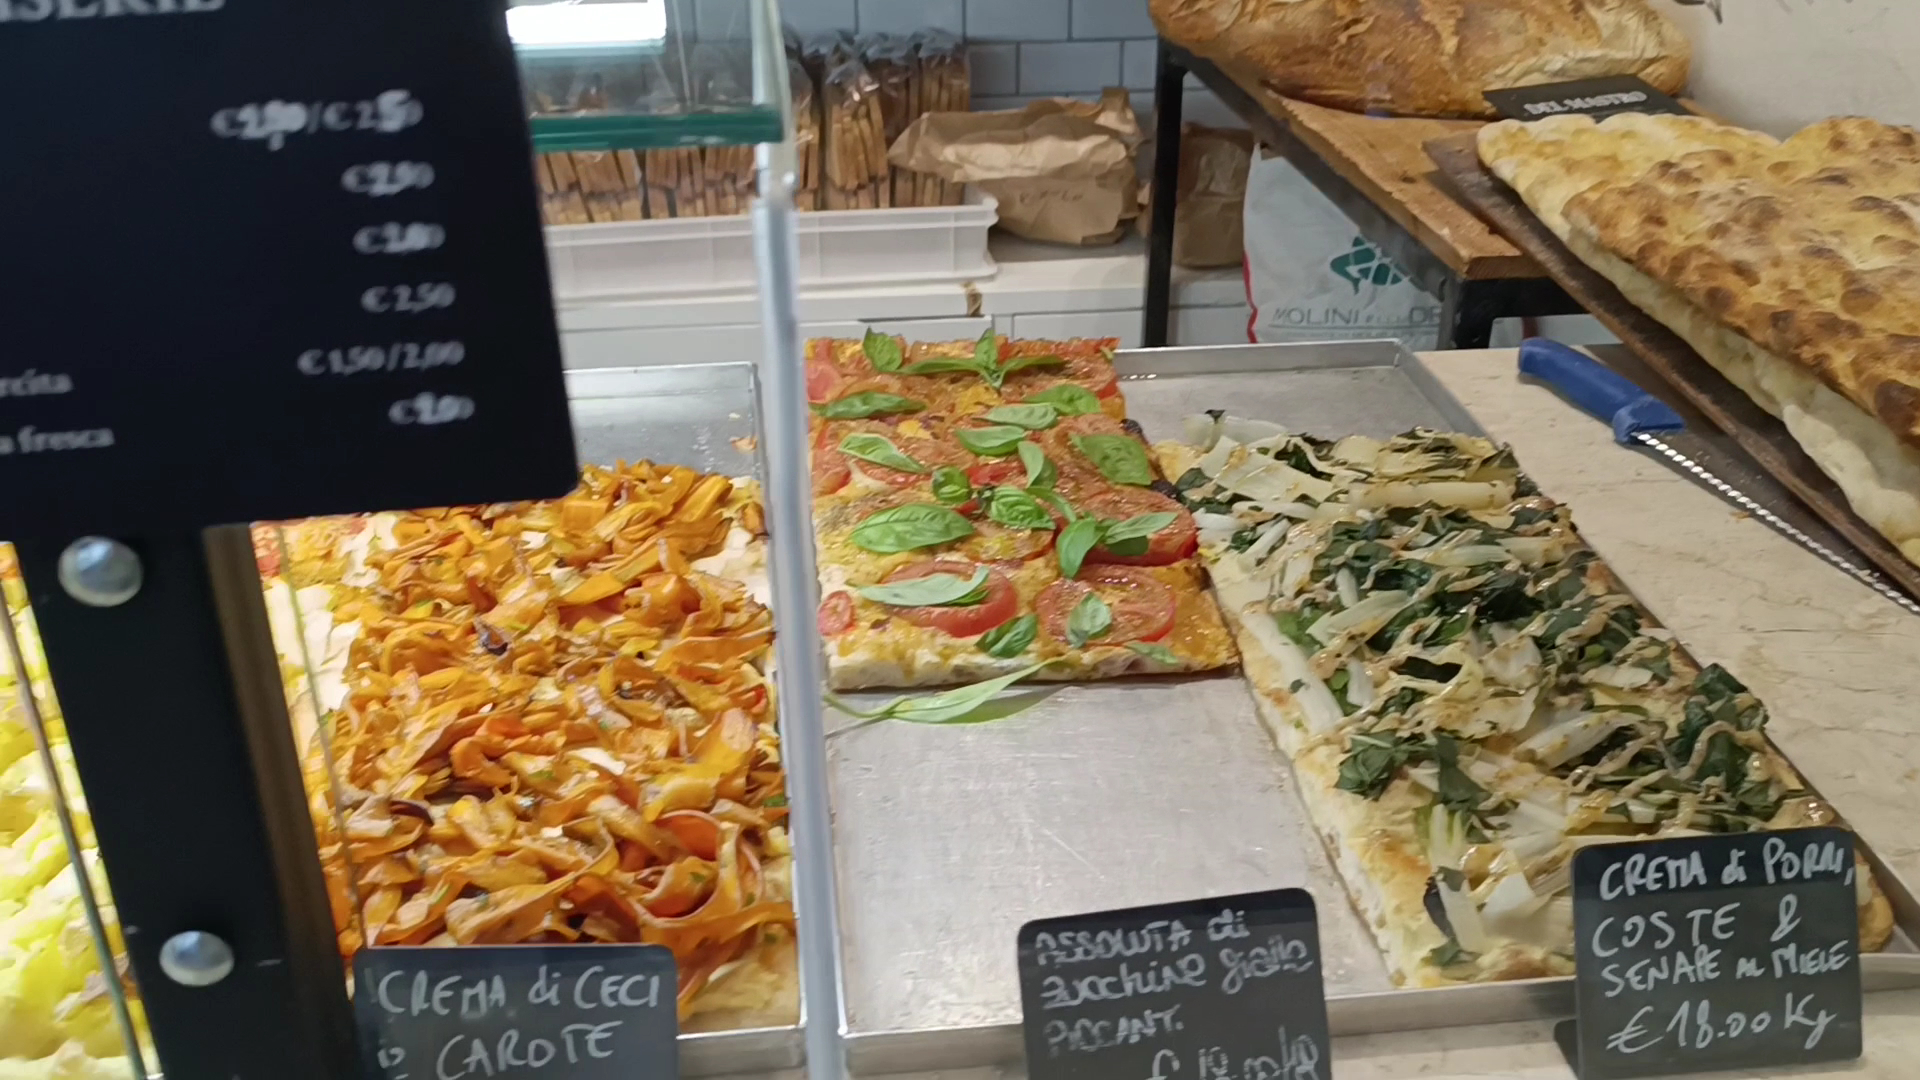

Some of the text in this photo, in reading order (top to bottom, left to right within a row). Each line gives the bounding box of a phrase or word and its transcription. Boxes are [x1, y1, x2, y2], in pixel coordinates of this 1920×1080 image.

[17, 425, 115, 454] fresca
[1600, 851, 1707, 901] CREMA
[1721, 849, 1747, 886] di
[1592, 902, 1741, 957] COSTE
[378, 965, 660, 1018] CREMA di CECI
[1601, 943, 1722, 998] SENAPE
[1772, 940, 1850, 979] MIELE
[436, 1020, 623, 1080] CAROTE
